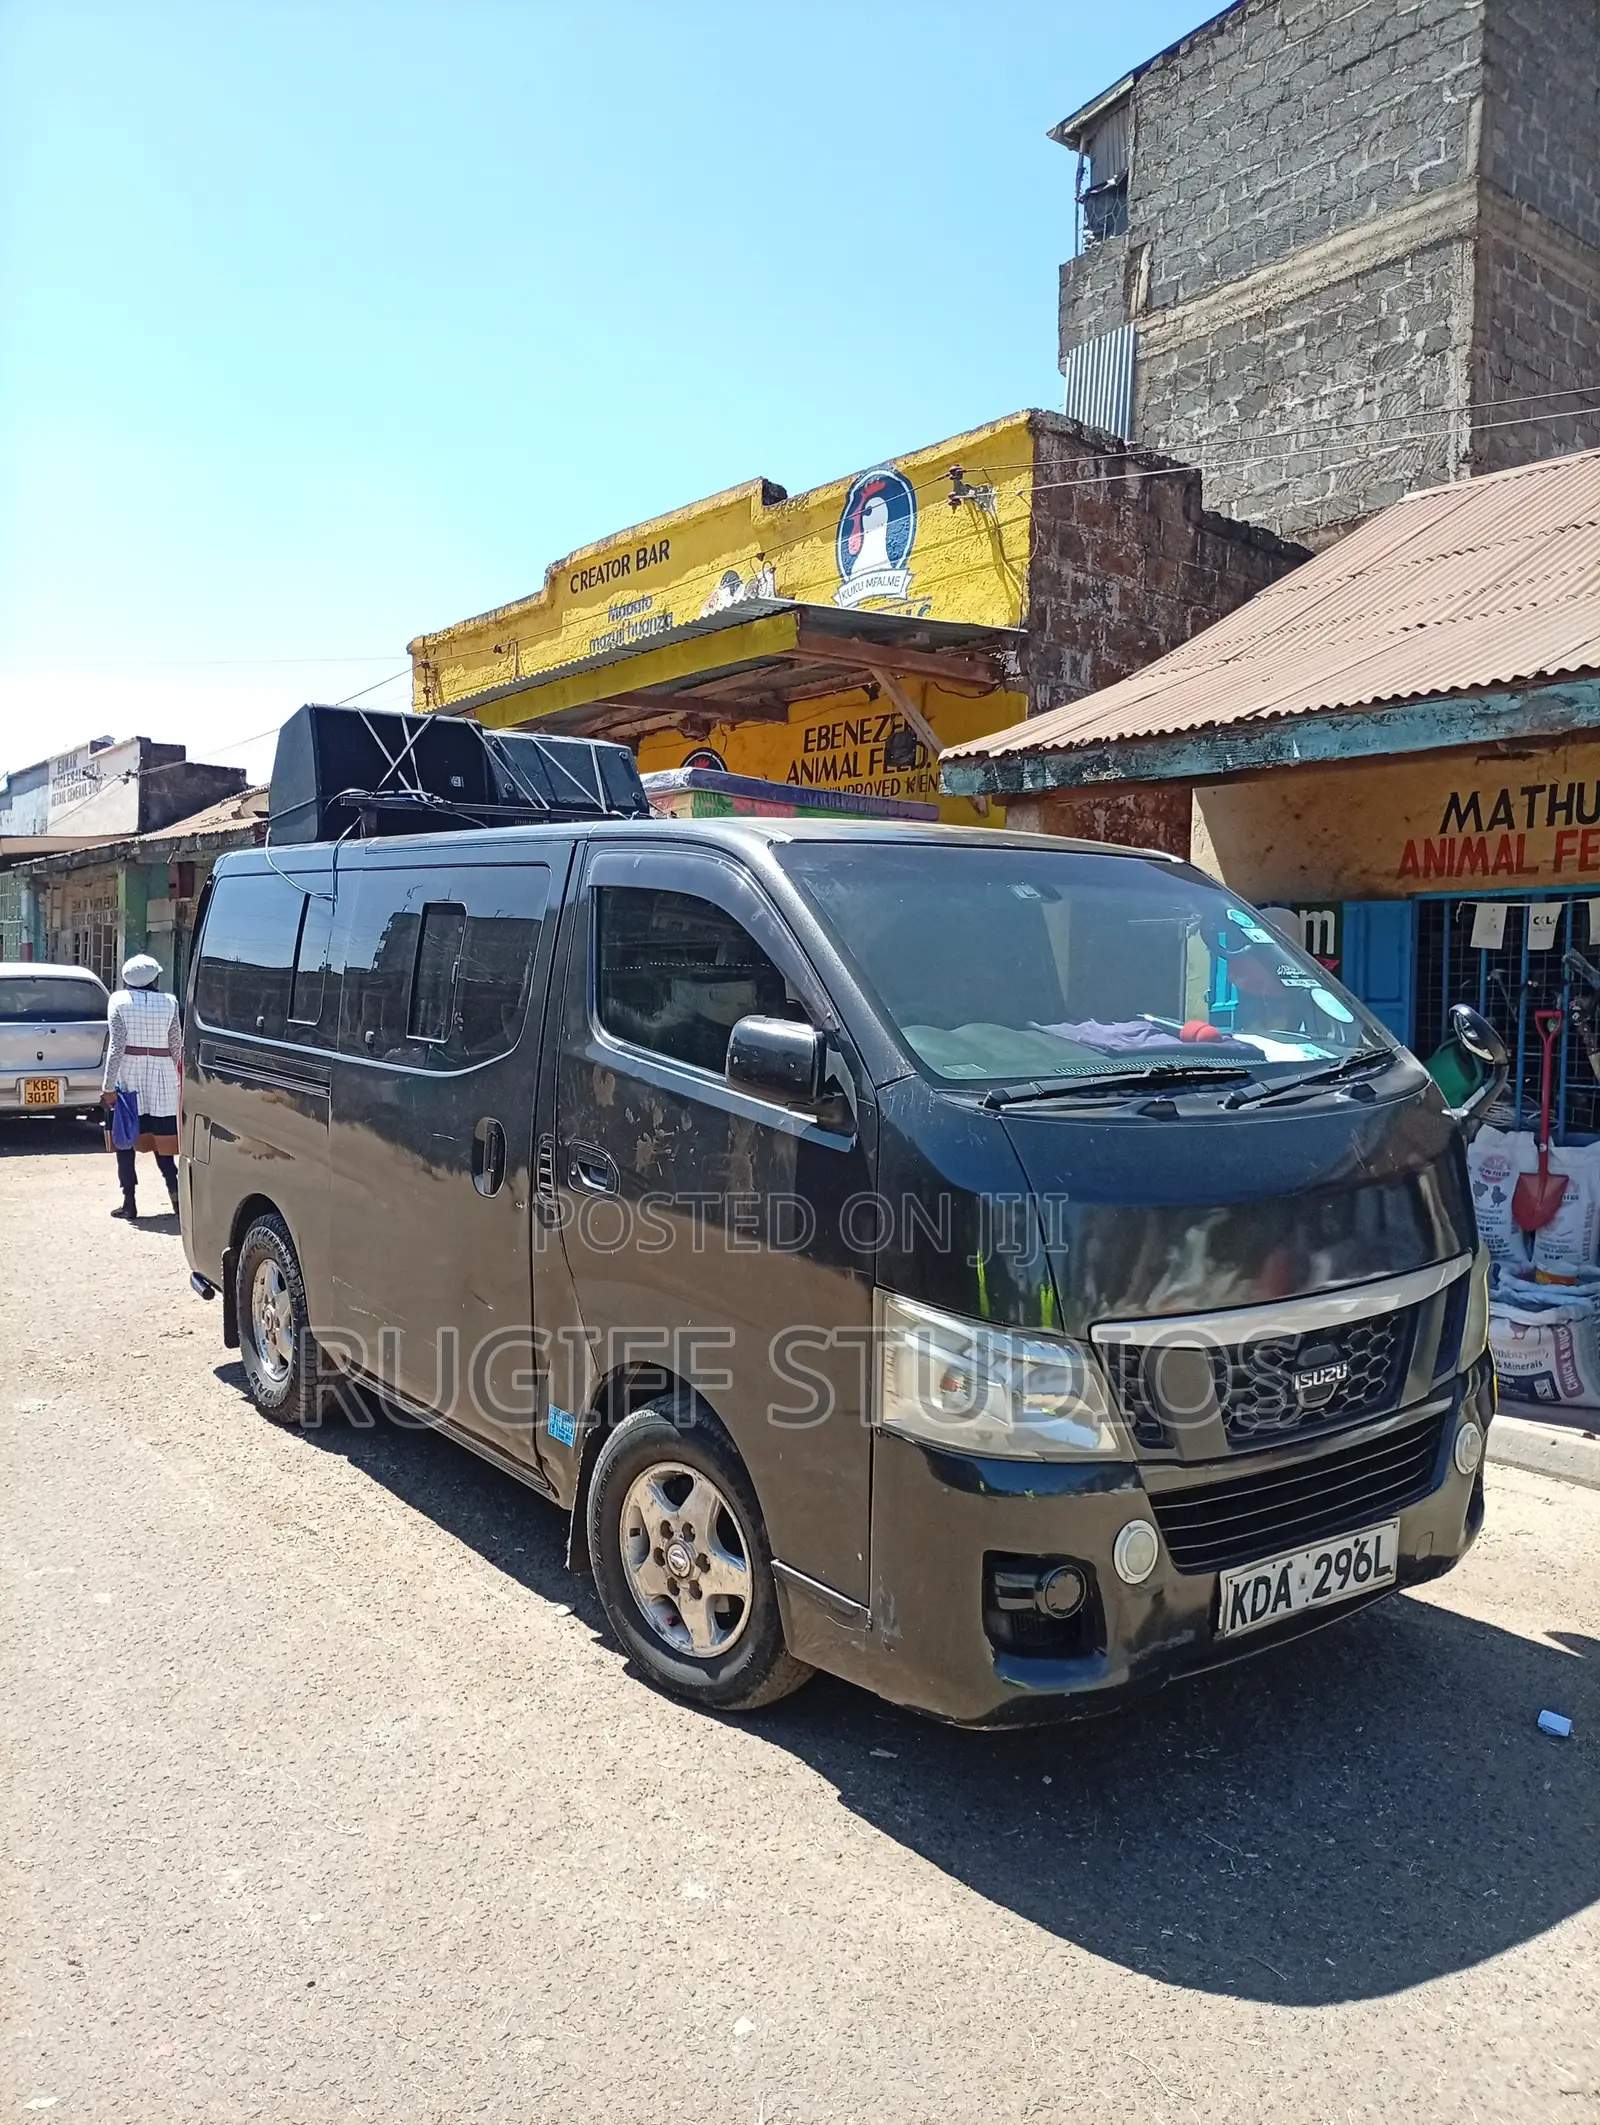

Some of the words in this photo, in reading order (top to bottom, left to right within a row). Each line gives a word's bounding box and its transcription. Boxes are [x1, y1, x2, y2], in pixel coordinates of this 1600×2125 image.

[570, 554, 631, 595] CREATOR
[636, 538, 670, 572] BAR
[841, 582, 865, 600] KUKU
[865, 575, 901, 588] MFALME
[787, 751, 862, 786] ANIMAL
[869, 741, 931, 776] FD.
[1438, 781, 1600, 834] MATHU
[1396, 833, 1539, 880] ANIMAL
[1553, 828, 1600, 874] FE
[27, 1092, 56, 1103] 301R
[33, 1080, 56, 1091] KBC
[1293, 1363, 1348, 1390] ISUZU
[1503, 1360, 1543, 1371] Minerals
[1563, 1362, 1579, 1391] CHICK
[1230, 1563, 1292, 1630] KDA
[1312, 1535, 1391, 1600] 296L
